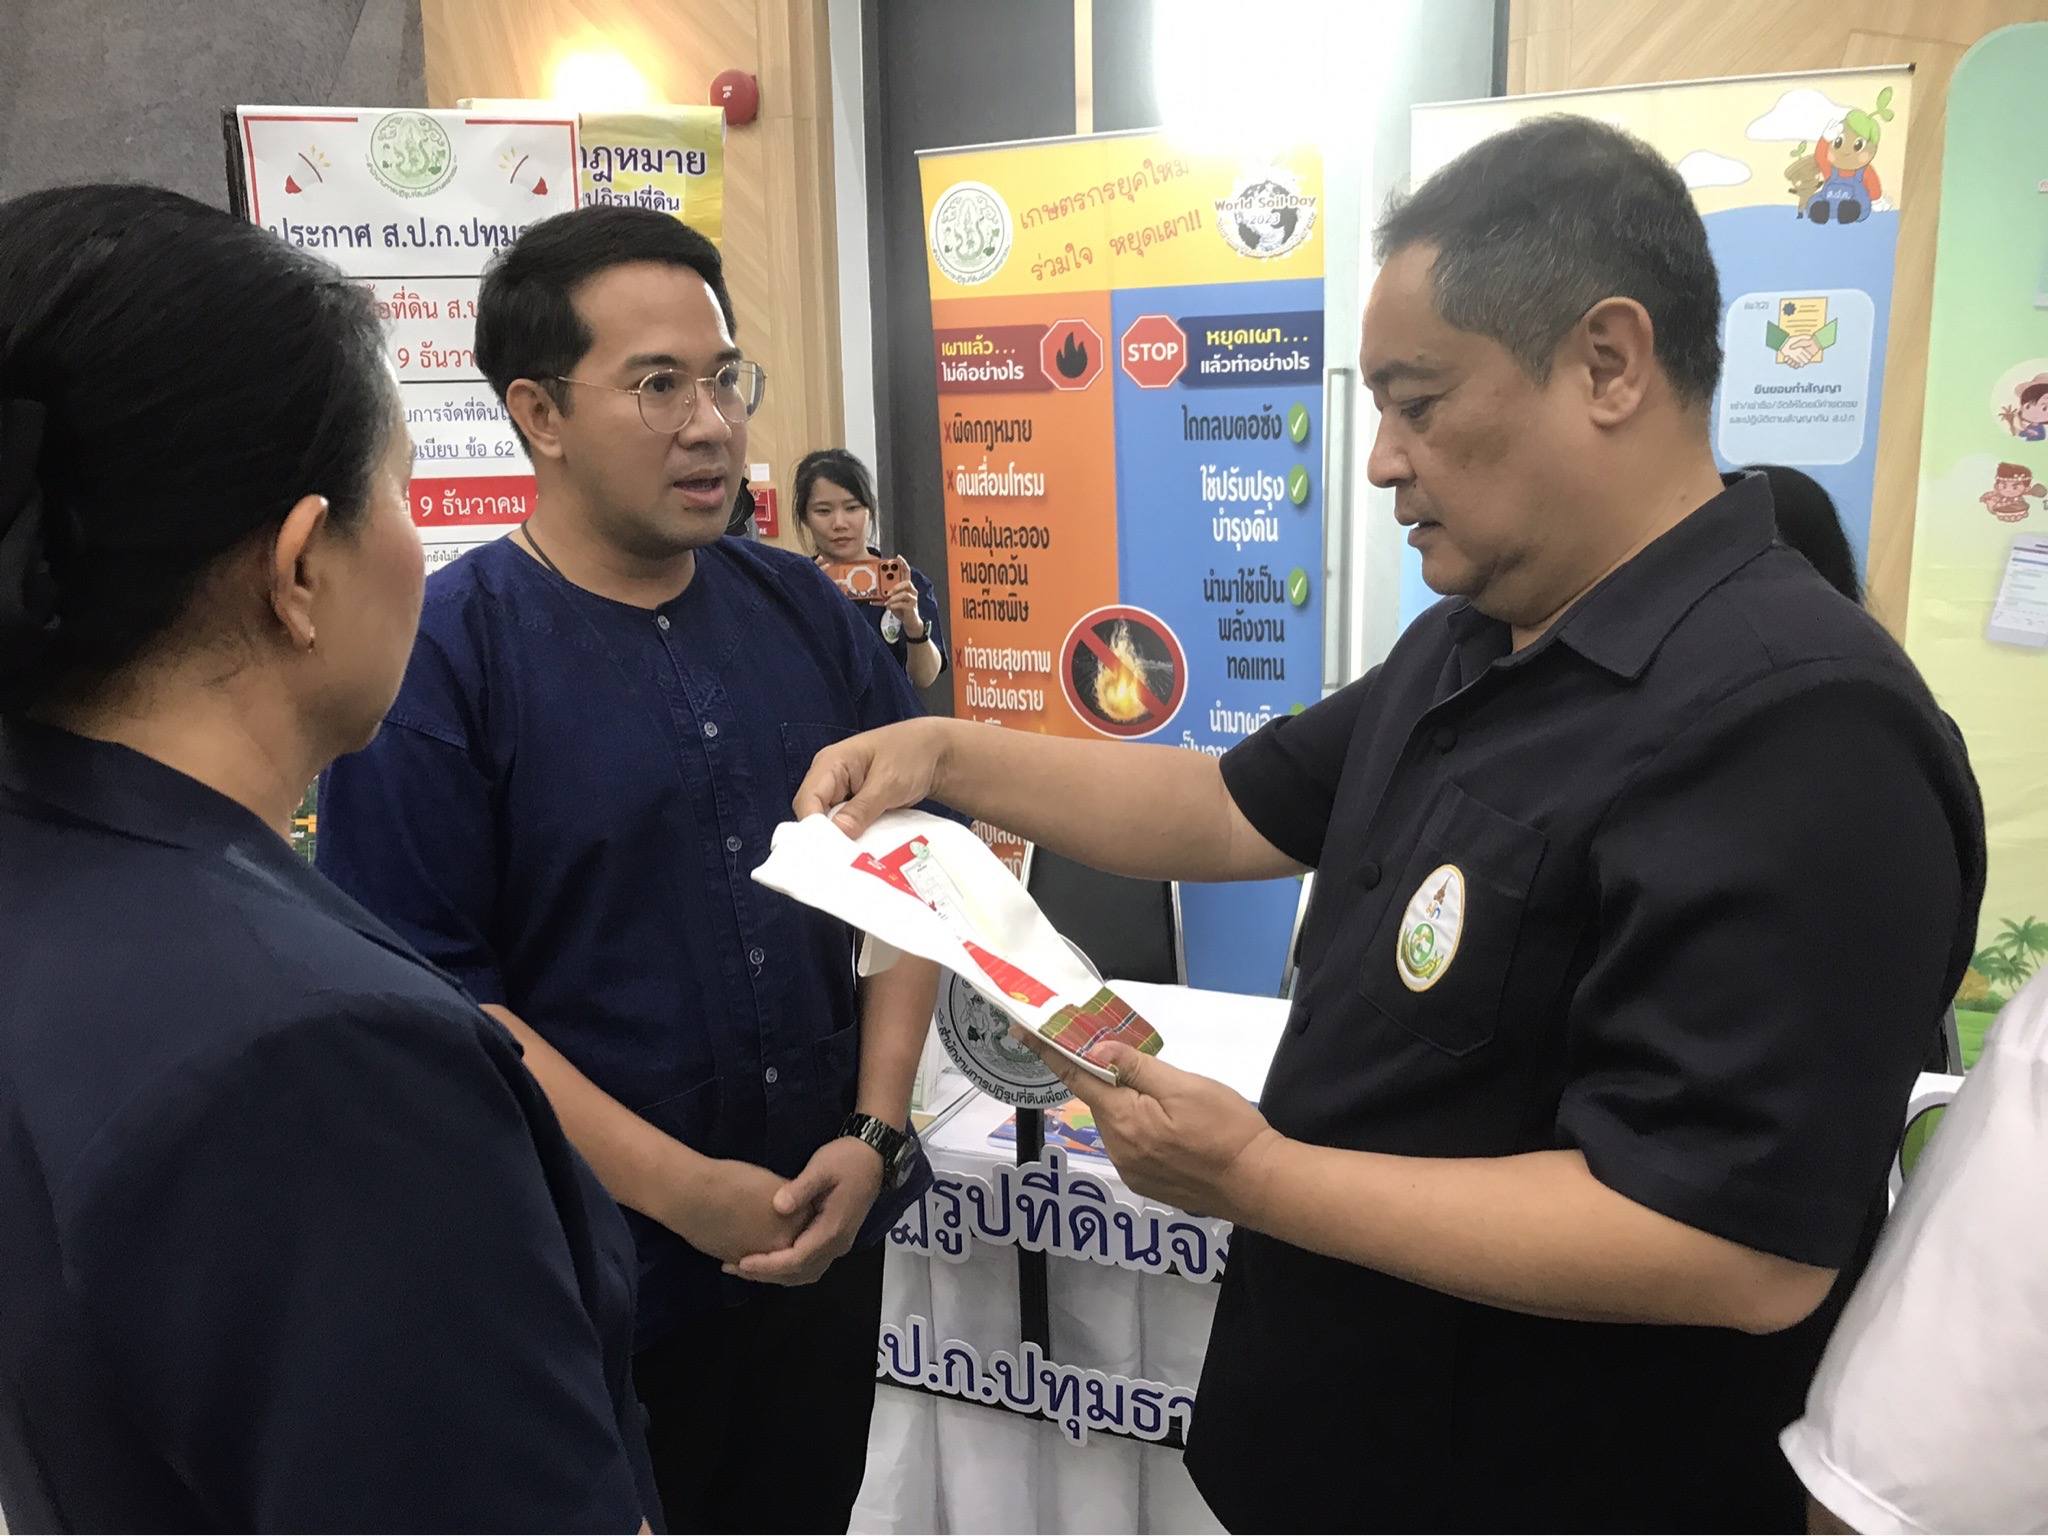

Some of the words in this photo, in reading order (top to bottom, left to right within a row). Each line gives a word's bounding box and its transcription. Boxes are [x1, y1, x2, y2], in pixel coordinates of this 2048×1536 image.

[1214, 198, 1253, 211] World
[1258, 195, 1285, 208] Soil
[1289, 195, 1316, 208] Day
[1249, 213, 1280, 225] 2023
[268, 217, 372, 248] ประกาศ
[1031, 243, 1093, 281] ร่วมใจ
[1109, 209, 1202, 258] หยุดเผา!!
[397, 348, 410, 368] 9
[420, 340, 476, 368] ธันวา
[1128, 342, 1179, 363] STOP
[1200, 350, 1311, 375] แล้วทำอย่างไร
[941, 360, 1025, 383] ไม่ดีอย่างไร
[953, 412, 1033, 452] ผิดกฎหมาย
[1182, 404, 1283, 442] ไถกลบตอซัง
[465, 436, 487, 457] ข้อ
[494, 441, 514, 456] 62
[956, 456, 1045, 498] ดินเสื่อมโทรม
[1200, 464, 1285, 512] ใช้ปรับปรุง
[420, 496, 433, 517] 9
[442, 488, 526, 516] ธันวาคม
[959, 516, 1050, 557] เกิดฝุ่นละออง
[1213, 508, 1279, 552] บำรุงดิน
[961, 556, 1029, 586] หมอกควัน
[1203, 564, 1285, 603] นำมาใช้เป็น
[963, 588, 1030, 622] และก๊าซพิษ
[1218, 609, 1285, 642] พลังงาน
[964, 638, 1051, 680] ทำลายสุขภาพ
[1226, 655, 1285, 681] ทดแทน
[966, 673, 1044, 711] เป็นอันตราย
[1209, 700, 1281, 735] นำมาผลิ
